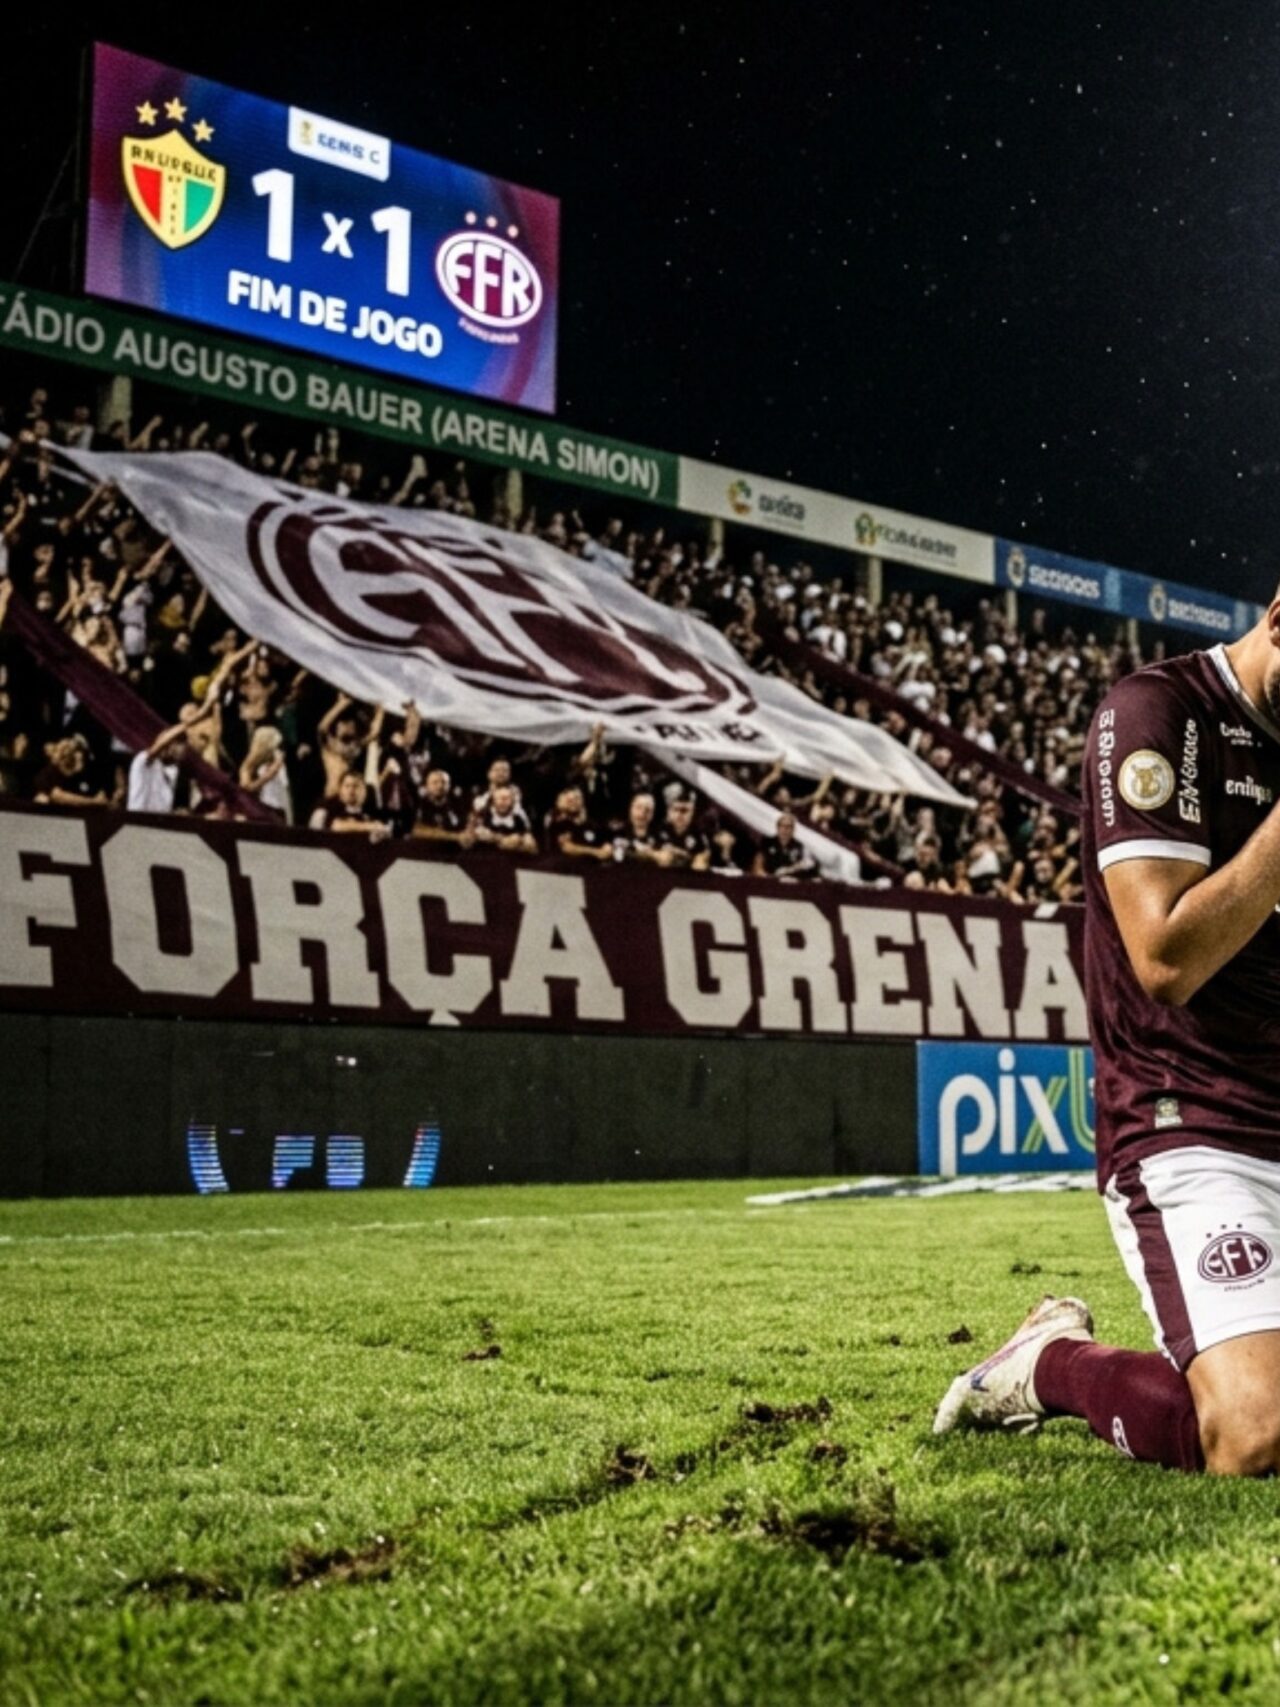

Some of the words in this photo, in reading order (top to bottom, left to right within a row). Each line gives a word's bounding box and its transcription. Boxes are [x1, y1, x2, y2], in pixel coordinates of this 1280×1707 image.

[228, 270, 292, 318] FIM
[299, 290, 348, 334] DE
[352, 306, 443, 358] JOGO
[252, 168, 294, 262] 1
[371, 206, 411, 296] 1
[0, 290, 104, 353] ÁDIO
[113, 328, 298, 401] AUGUSTO
[307, 375, 423, 434] BAUER
[431, 406, 550, 465] (ARENA
[557, 438, 660, 498] SIMON)
[0, 812, 625, 1026] FORÇA
[658, 889, 1090, 1040] GRENÁ
